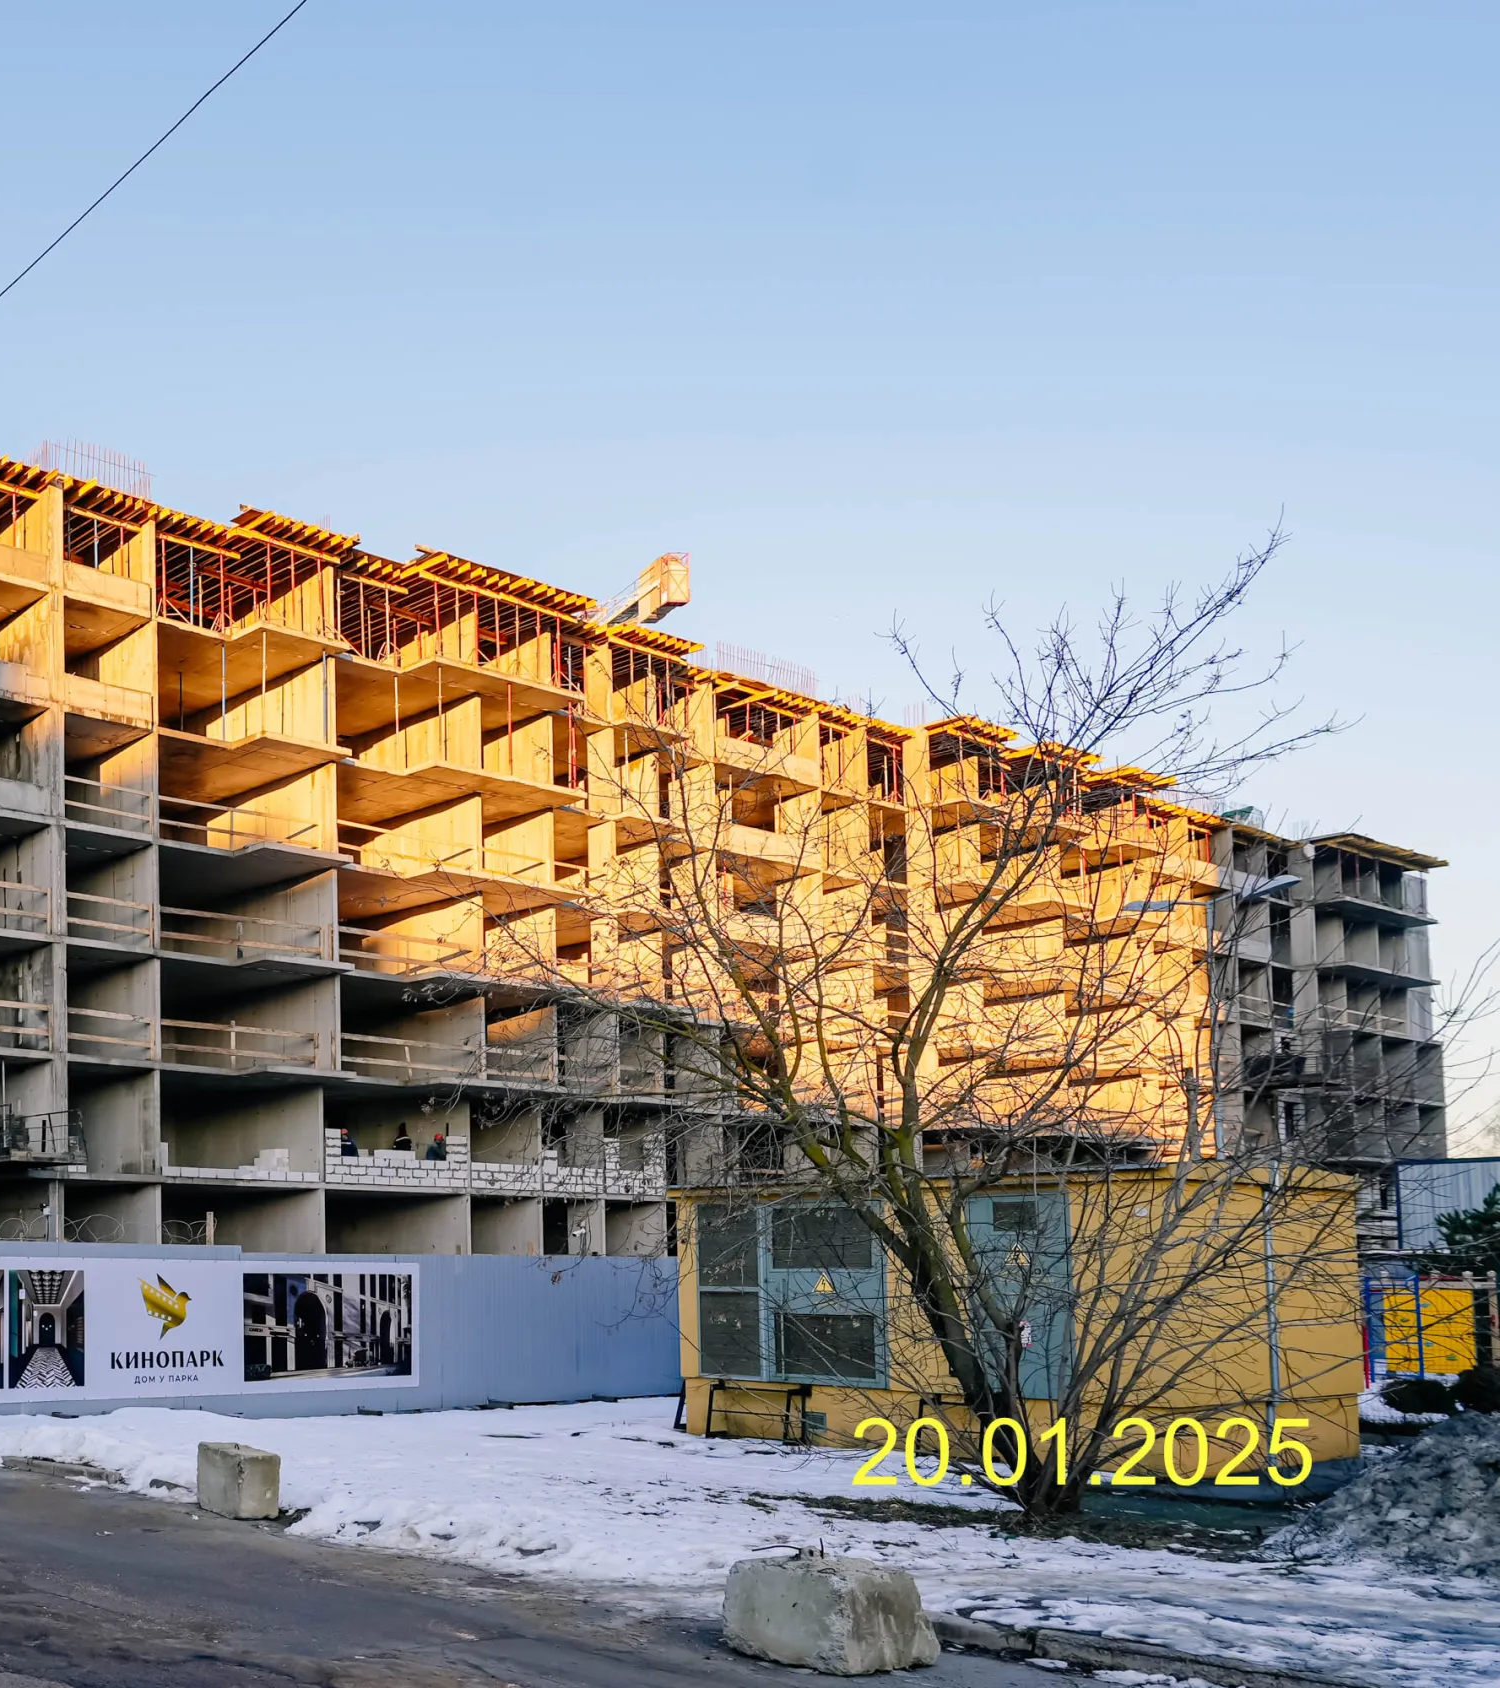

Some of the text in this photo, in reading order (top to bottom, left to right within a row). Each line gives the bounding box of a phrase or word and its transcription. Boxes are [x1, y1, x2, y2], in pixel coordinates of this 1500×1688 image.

[110, 1349, 225, 1370] КИНОПАРК
[134, 1374, 199, 1385] ДОМ У ПАРКА
